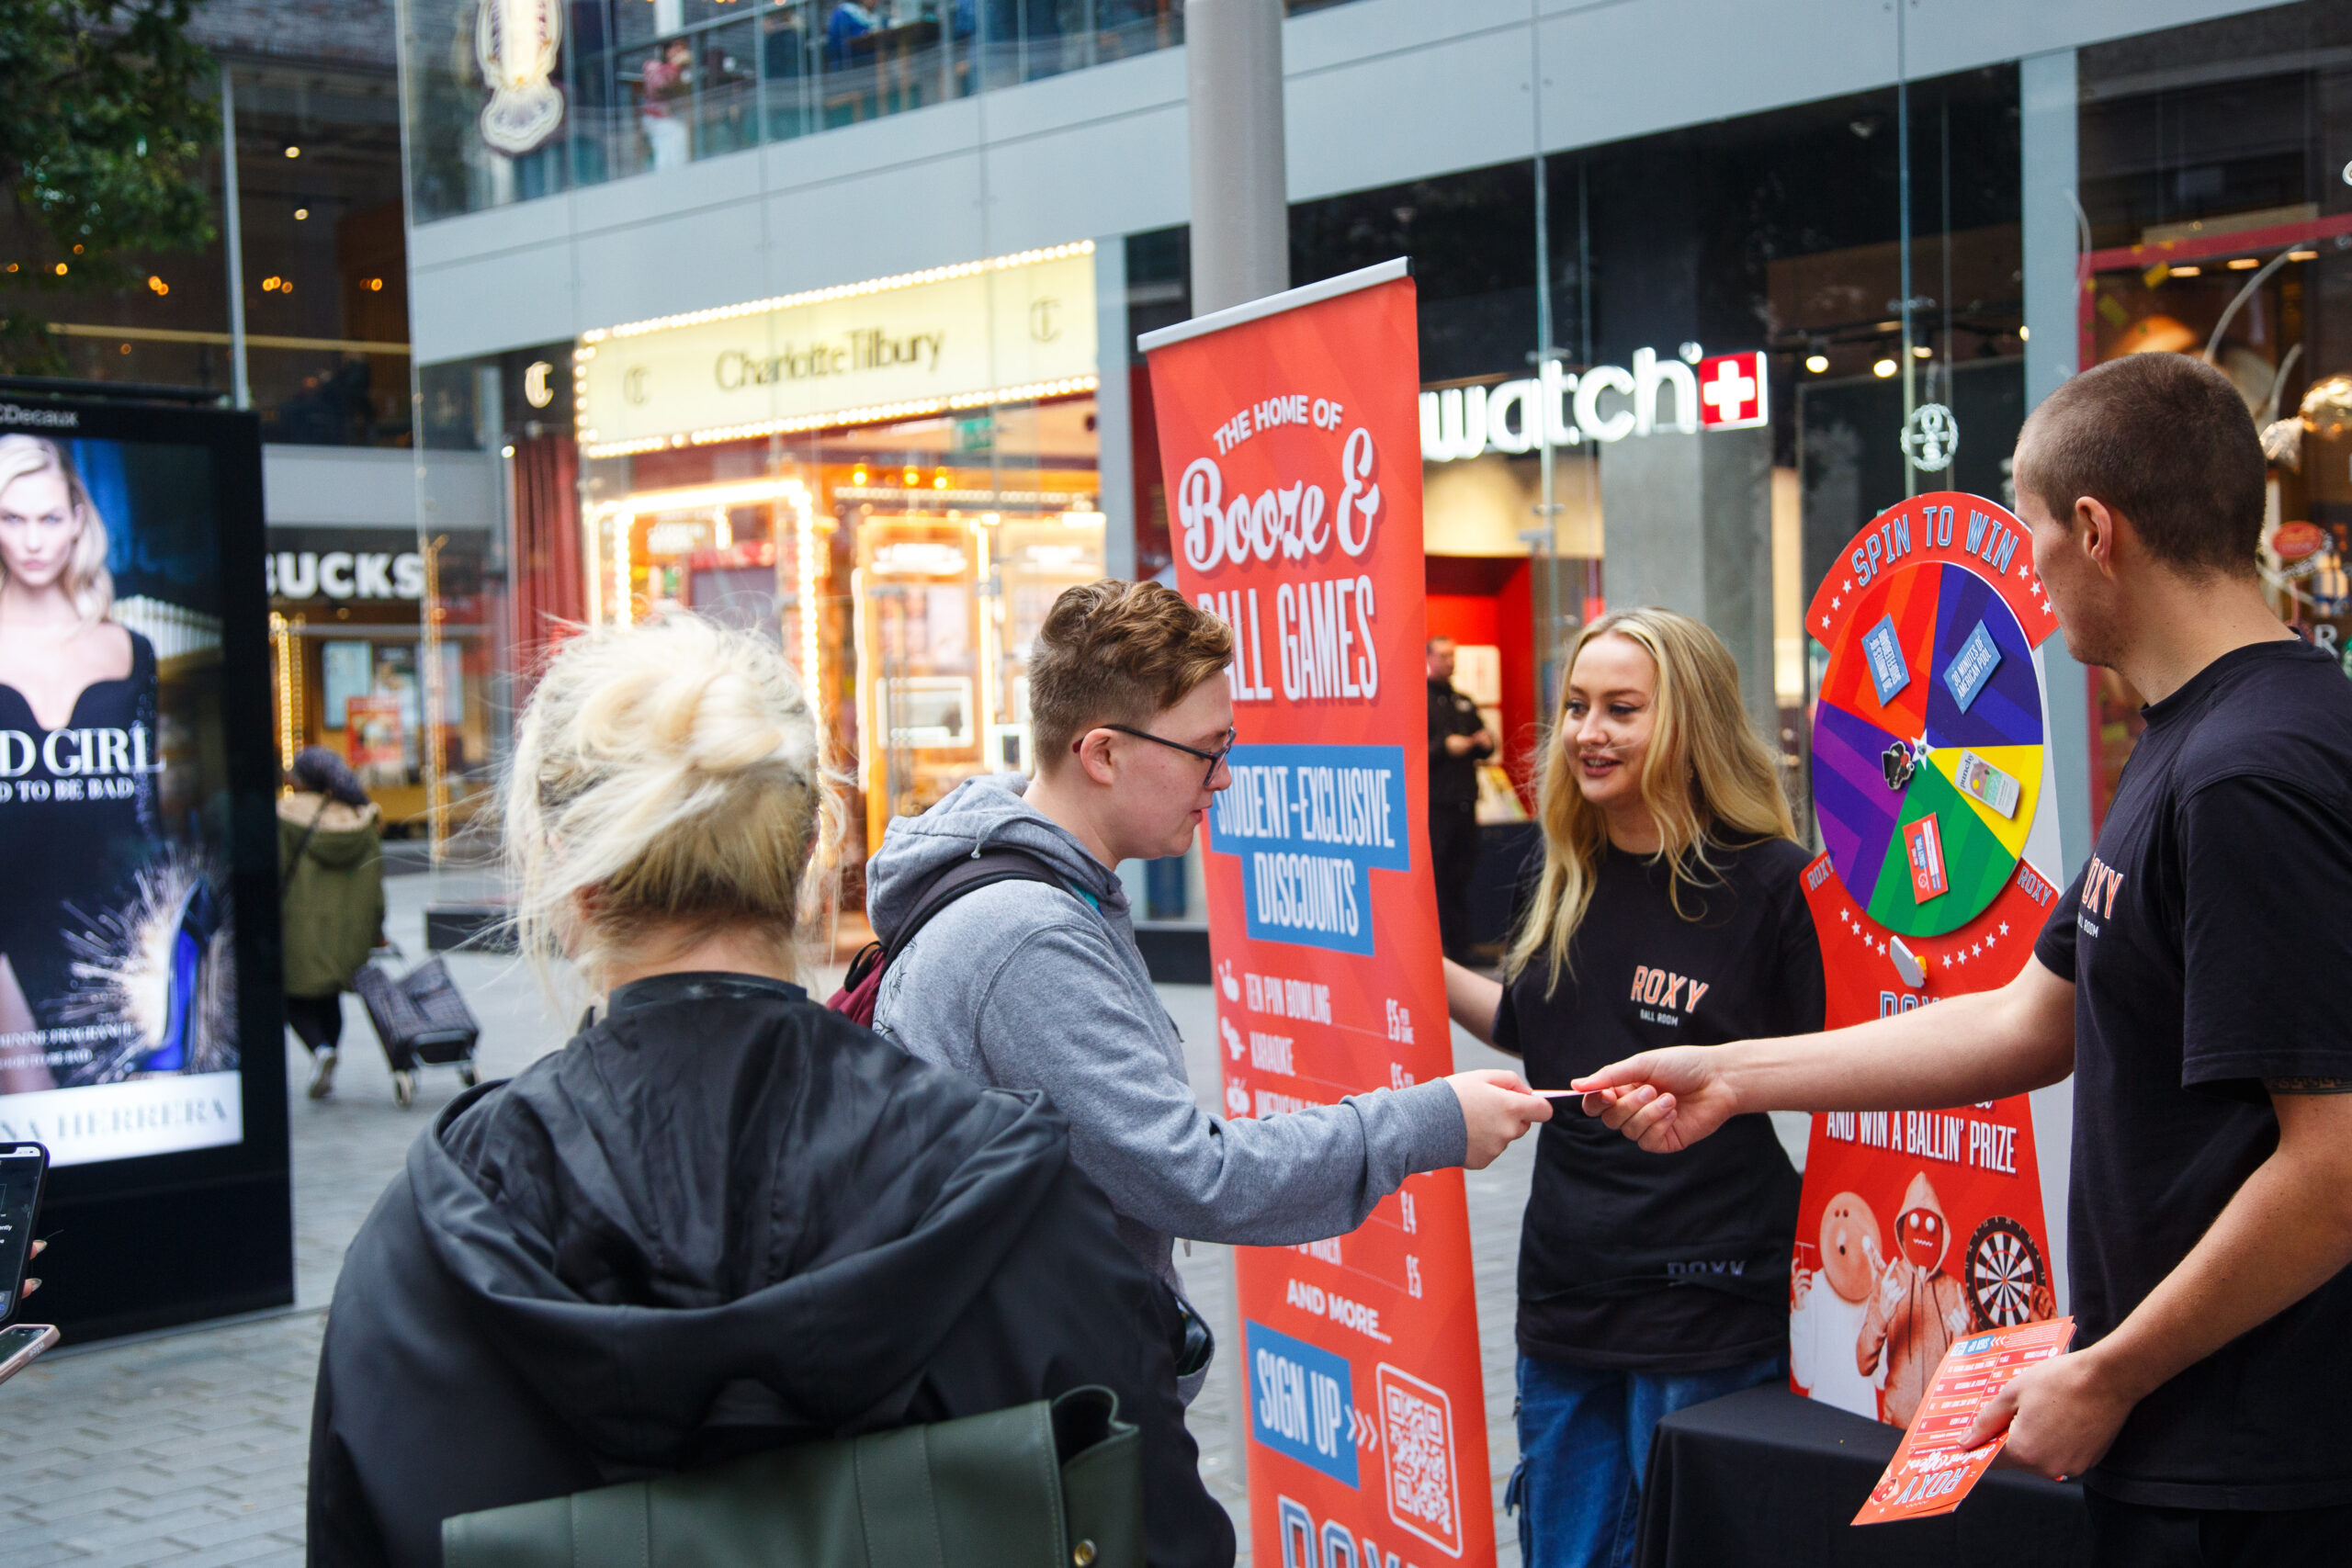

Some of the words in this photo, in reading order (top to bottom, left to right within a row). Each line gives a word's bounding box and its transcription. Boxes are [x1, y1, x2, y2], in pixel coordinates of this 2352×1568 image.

[715, 342, 846, 391] Charlotte
[845, 328, 944, 373] Tilbury
[1213, 410, 1252, 457] THE
[1253, 394, 1309, 431] HOME
[1312, 398, 1343, 431] OF
[1178, 457, 1330, 571] Booze
[1337, 427, 1380, 557] &
[1851, 514, 1911, 587] SPIN
[1923, 505, 1955, 548] TO
[1965, 509, 2019, 575] WIN
[1197, 588, 1273, 701] LL
[1277, 574, 1379, 702] GAMES
[1957, 643, 1979, 678] MINUTES
[1956, 661, 1981, 700] AMERICAN
[1976, 644, 1992, 671] POOL
[42, 728, 166, 776] GIRL
[1253, 852, 1359, 937] DISCOUNTS
[2017, 866, 2052, 908] ROXY
[2082, 852, 2124, 919] OXY
[1630, 964, 1709, 1013] ROXY
[1826, 1111, 1855, 1142] AND
[1860, 1111, 1888, 1148] WIN
[1892, 1111, 1902, 1151] A
[1906, 1111, 1964, 1163] BALLIN'
[1969, 1121, 2018, 1174] PRIZE
[1400, 1190, 1416, 1235] £4
[1286, 1279, 1326, 1316] AND
[1406, 1254, 1422, 1299] £5
[1257, 1348, 1309, 1447] SIGN
[1310, 1371, 1342, 1459] UP
[1893, 1465, 1971, 1506] ROXY
